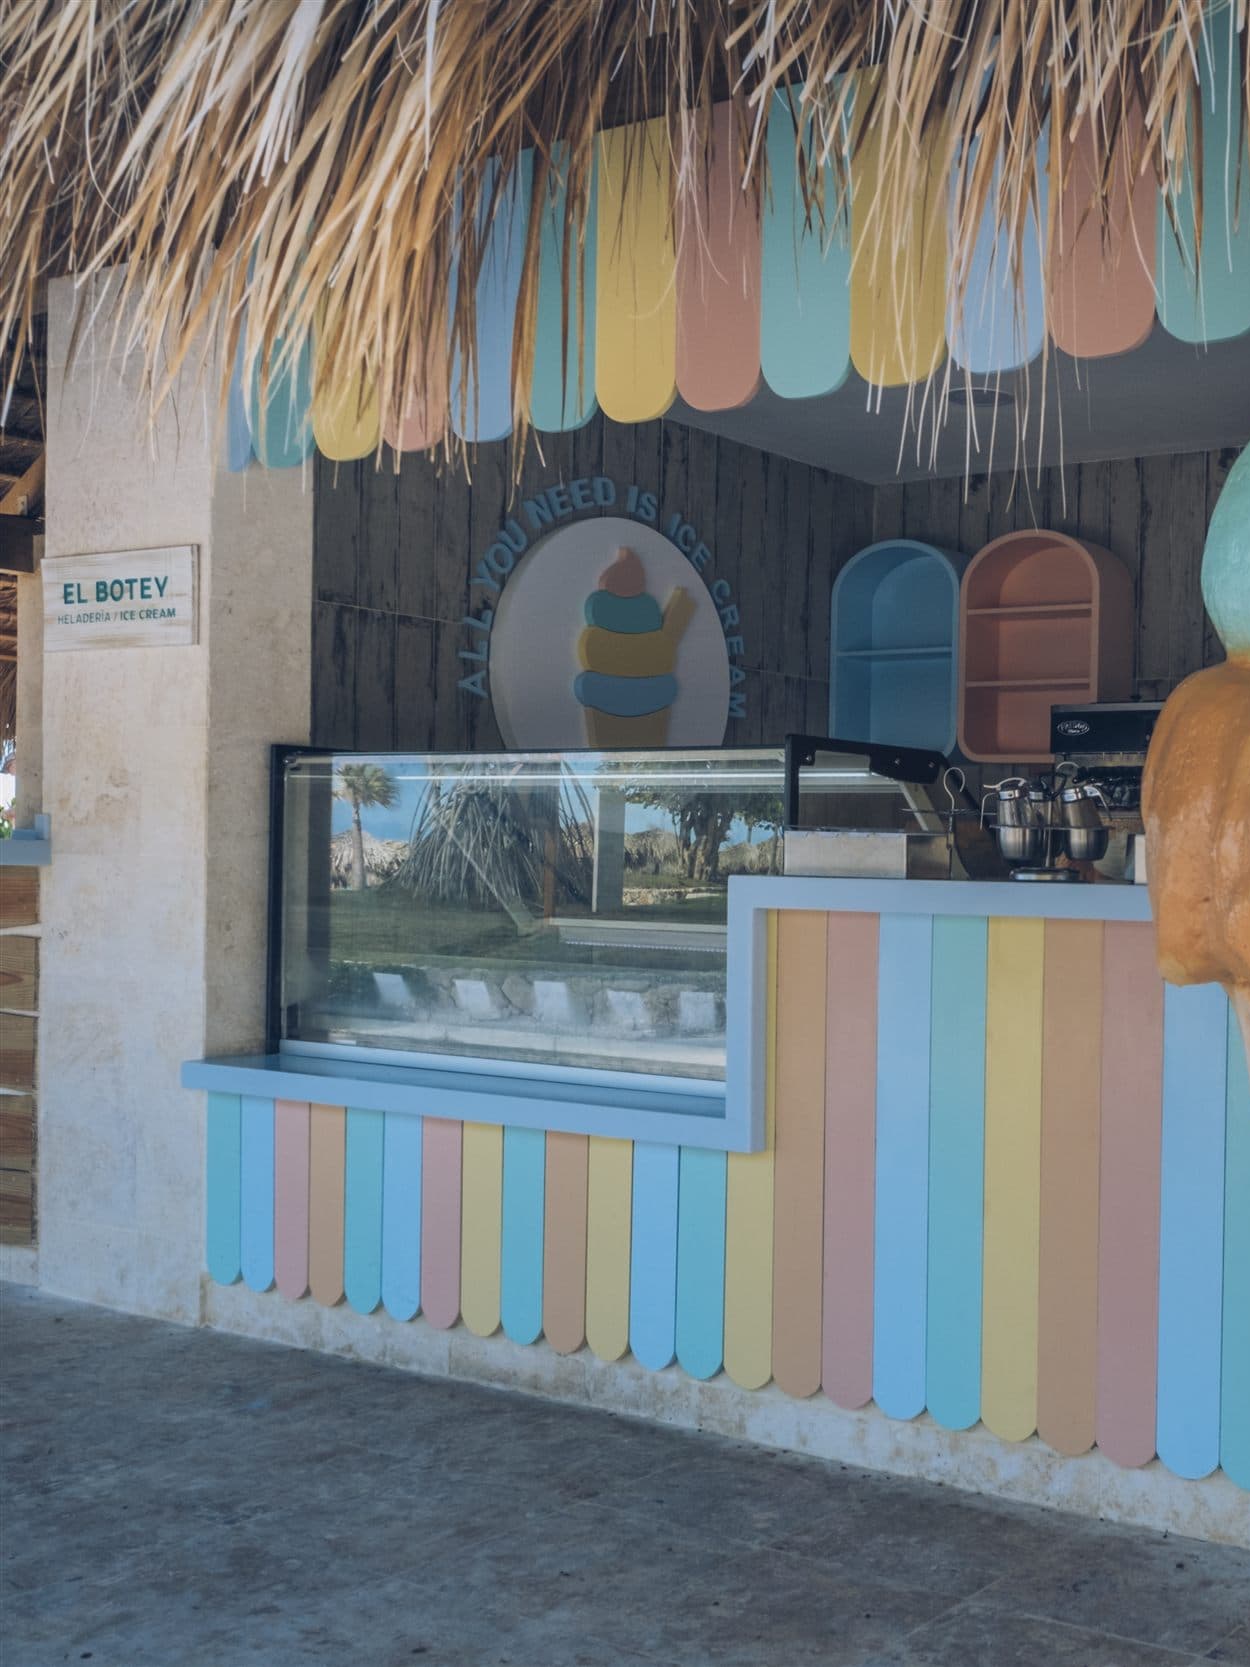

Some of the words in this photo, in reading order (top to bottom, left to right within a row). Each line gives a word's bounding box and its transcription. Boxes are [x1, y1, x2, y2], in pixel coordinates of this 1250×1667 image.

[522, 476, 617, 529] NEED
[625, 485, 657, 522] IS
[468, 519, 528, 593] YOU
[665, 512, 711, 573] ICE
[63, 582, 88, 605] EL
[95, 575, 168, 603] BOTEY
[120, 610, 136, 621] ICE
[139, 607, 176, 620] CREAM
[457, 606, 493, 699] ALL
[711, 578, 747, 719] CREAM
